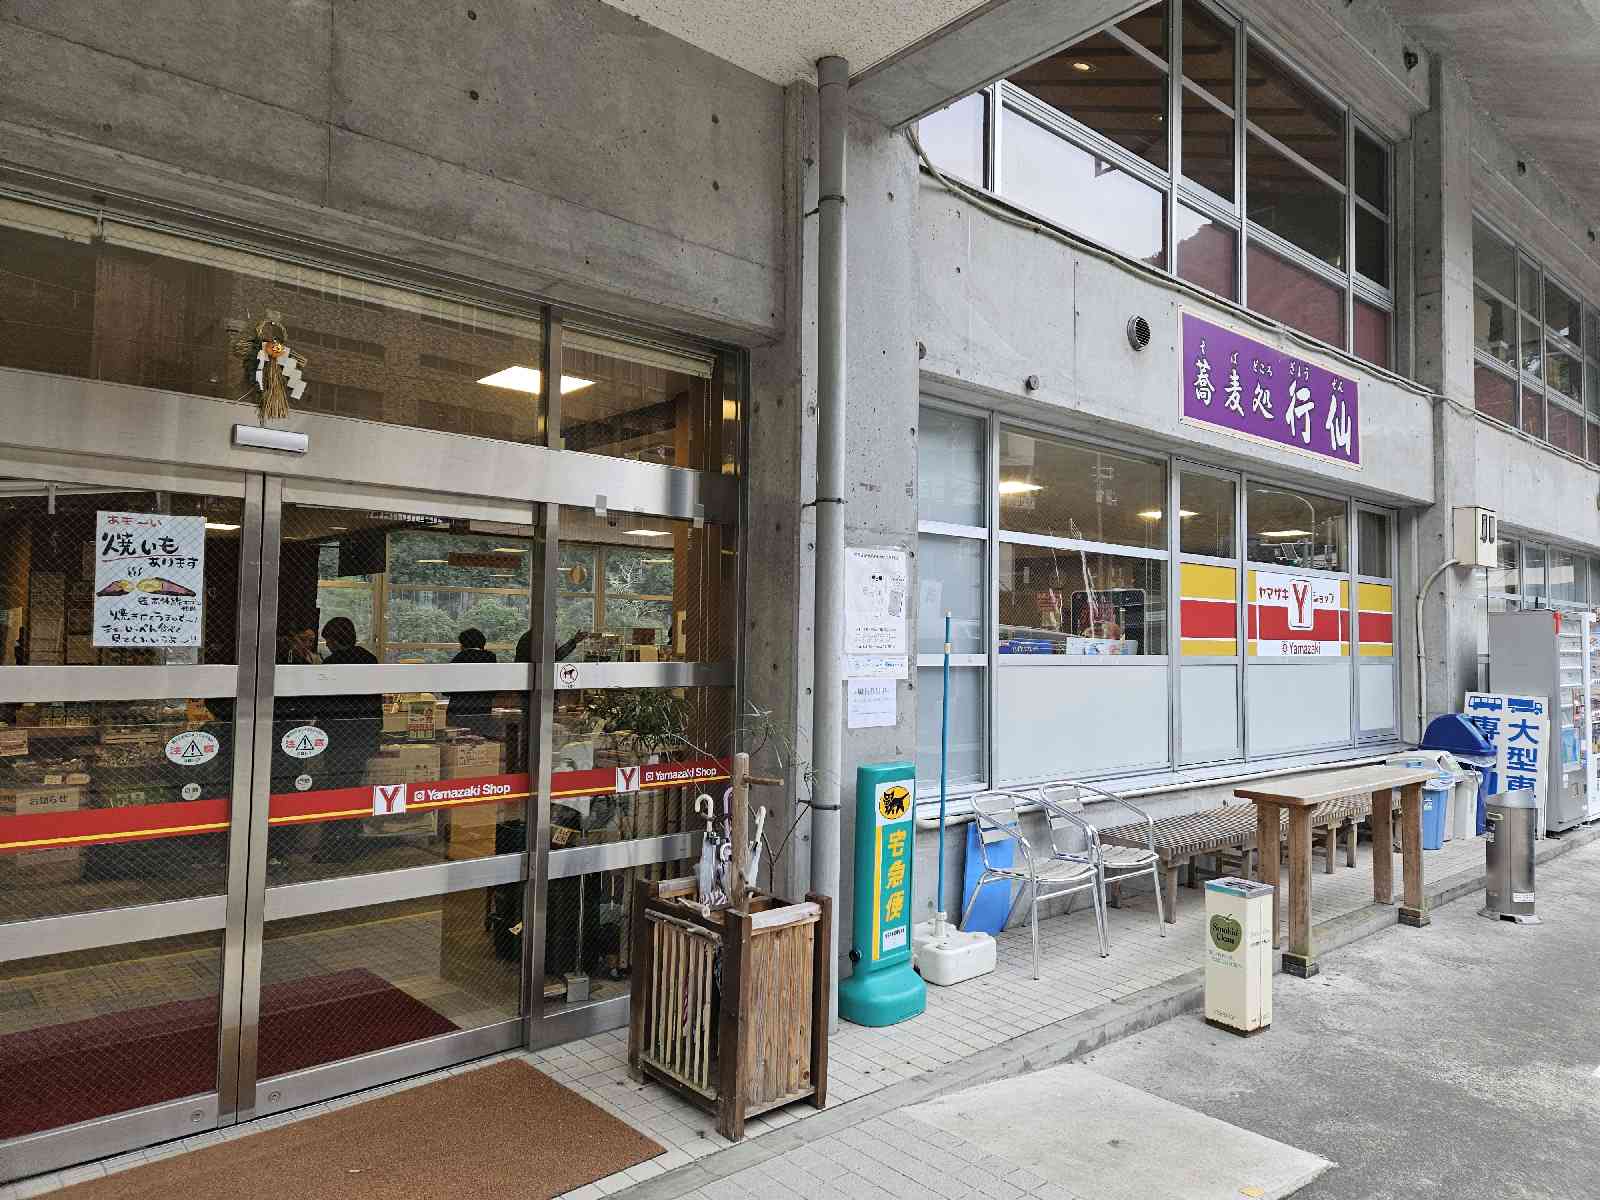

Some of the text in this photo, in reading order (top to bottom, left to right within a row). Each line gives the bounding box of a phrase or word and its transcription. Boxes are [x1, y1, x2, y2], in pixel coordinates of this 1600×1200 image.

[102, 532, 179, 556] 焼いも
[148, 557, 199, 569] あります
[1259, 586, 1289, 601] ヤマザキ
[1312, 591, 1336, 604] ショップ
[1289, 641, 1321, 655] Yamazaki
[655, 768, 695, 781] Yamazaki
[695, 766, 717, 778] Shop
[427, 785, 482, 801] Yamazaki
[482, 783, 512, 797] Shop
[884, 830, 908, 923] 宅急便
